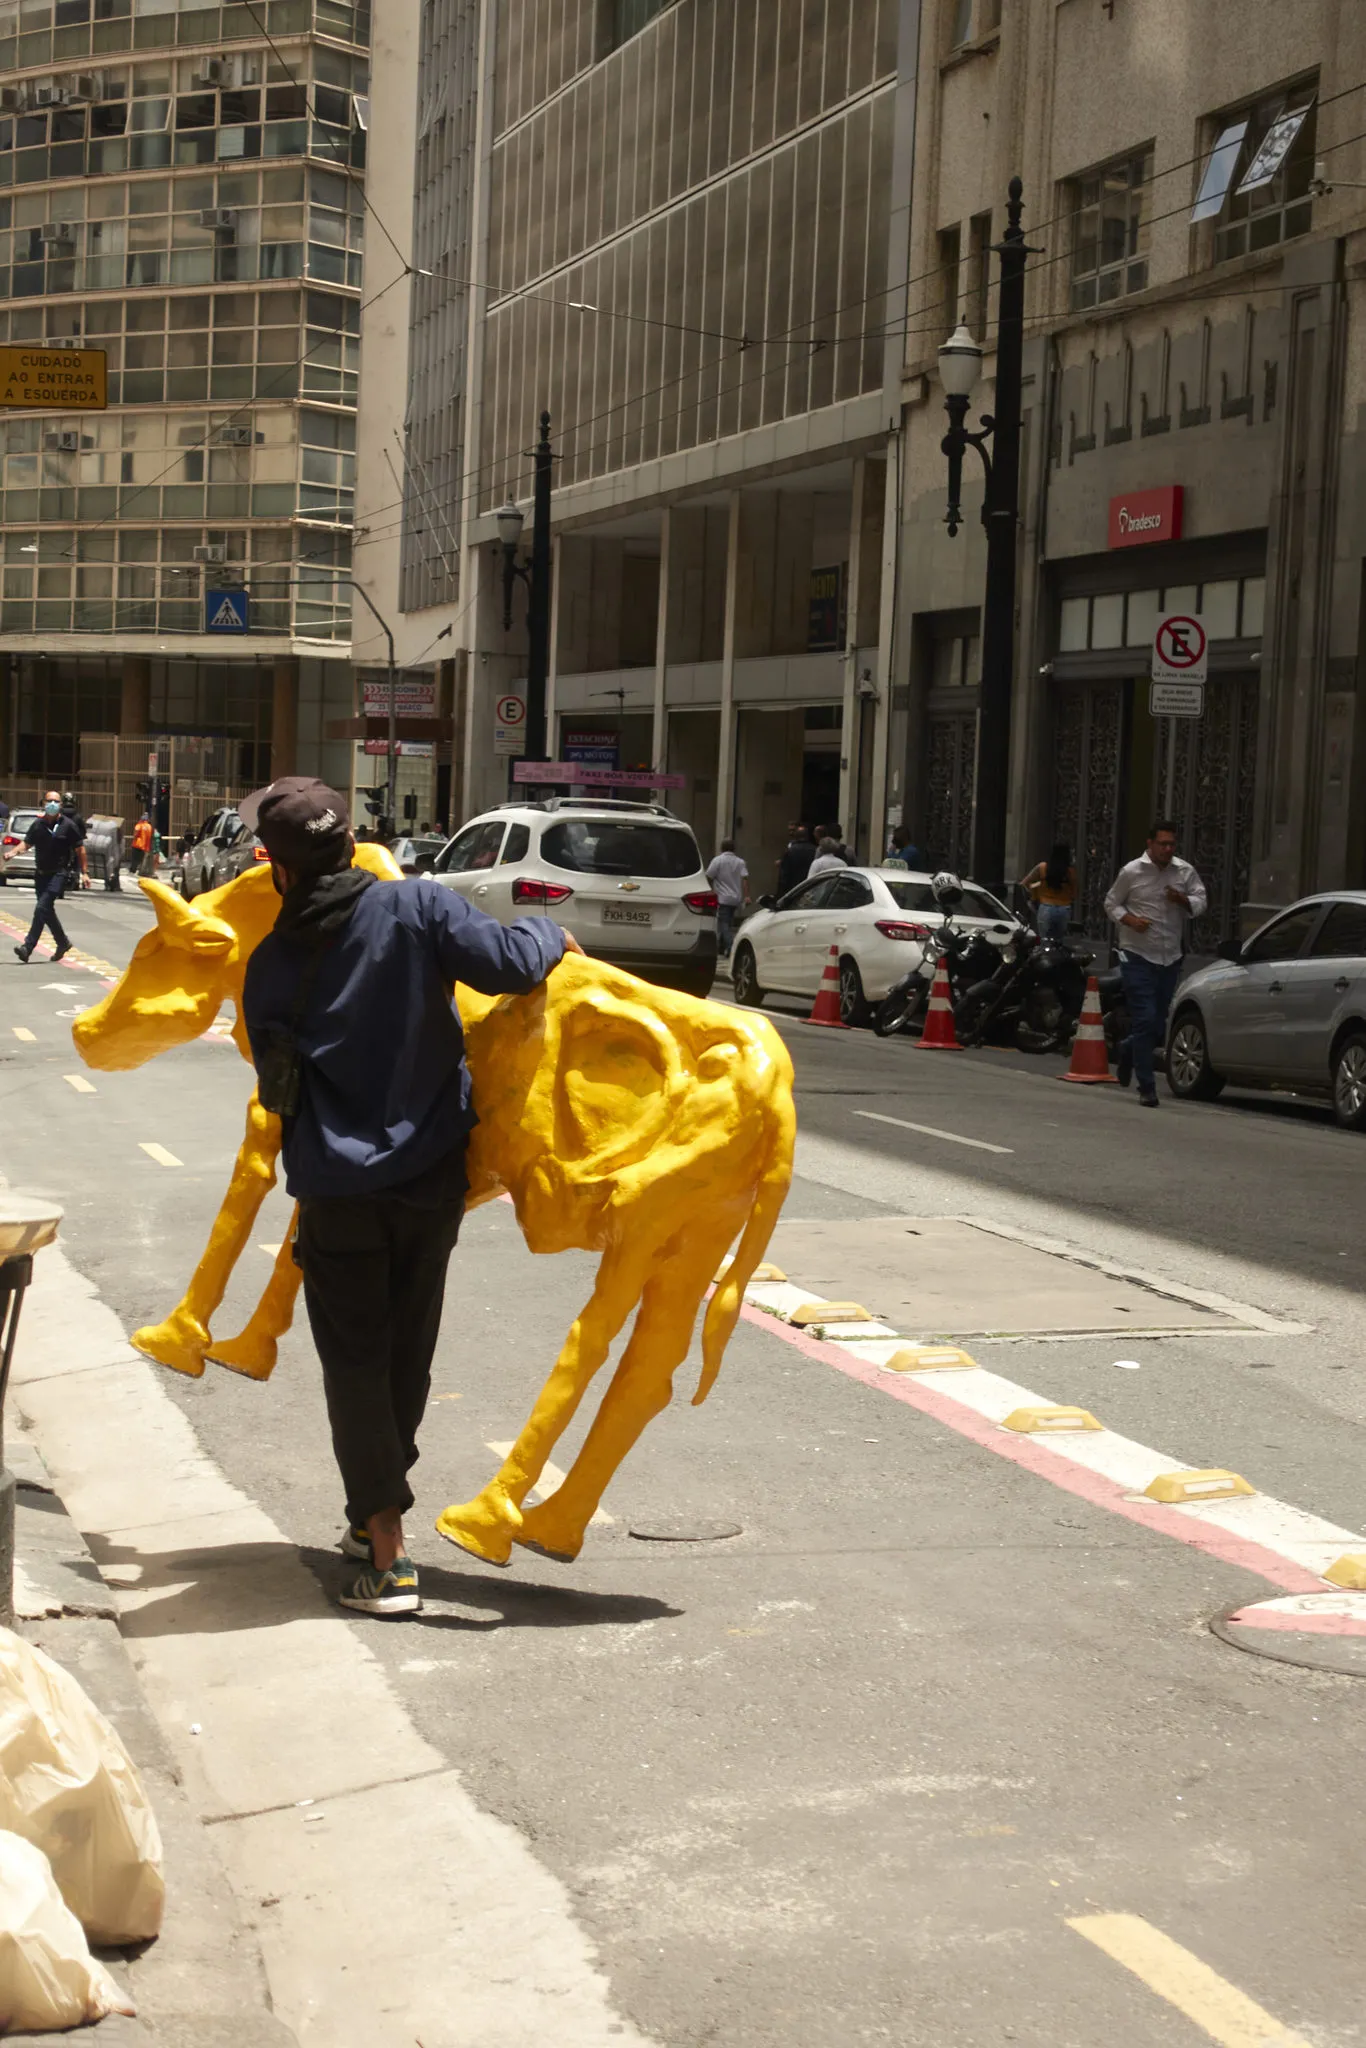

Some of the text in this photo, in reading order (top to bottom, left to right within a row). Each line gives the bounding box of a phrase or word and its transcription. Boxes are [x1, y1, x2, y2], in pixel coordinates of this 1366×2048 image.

[21, 355, 82, 369] CUIDADO
[8, 371, 95, 385] AO ENTRAR
[4, 388, 98, 401] A ESQUERDA
[1128, 513, 1161, 532] bradesco
[506, 702, 517, 718] E
